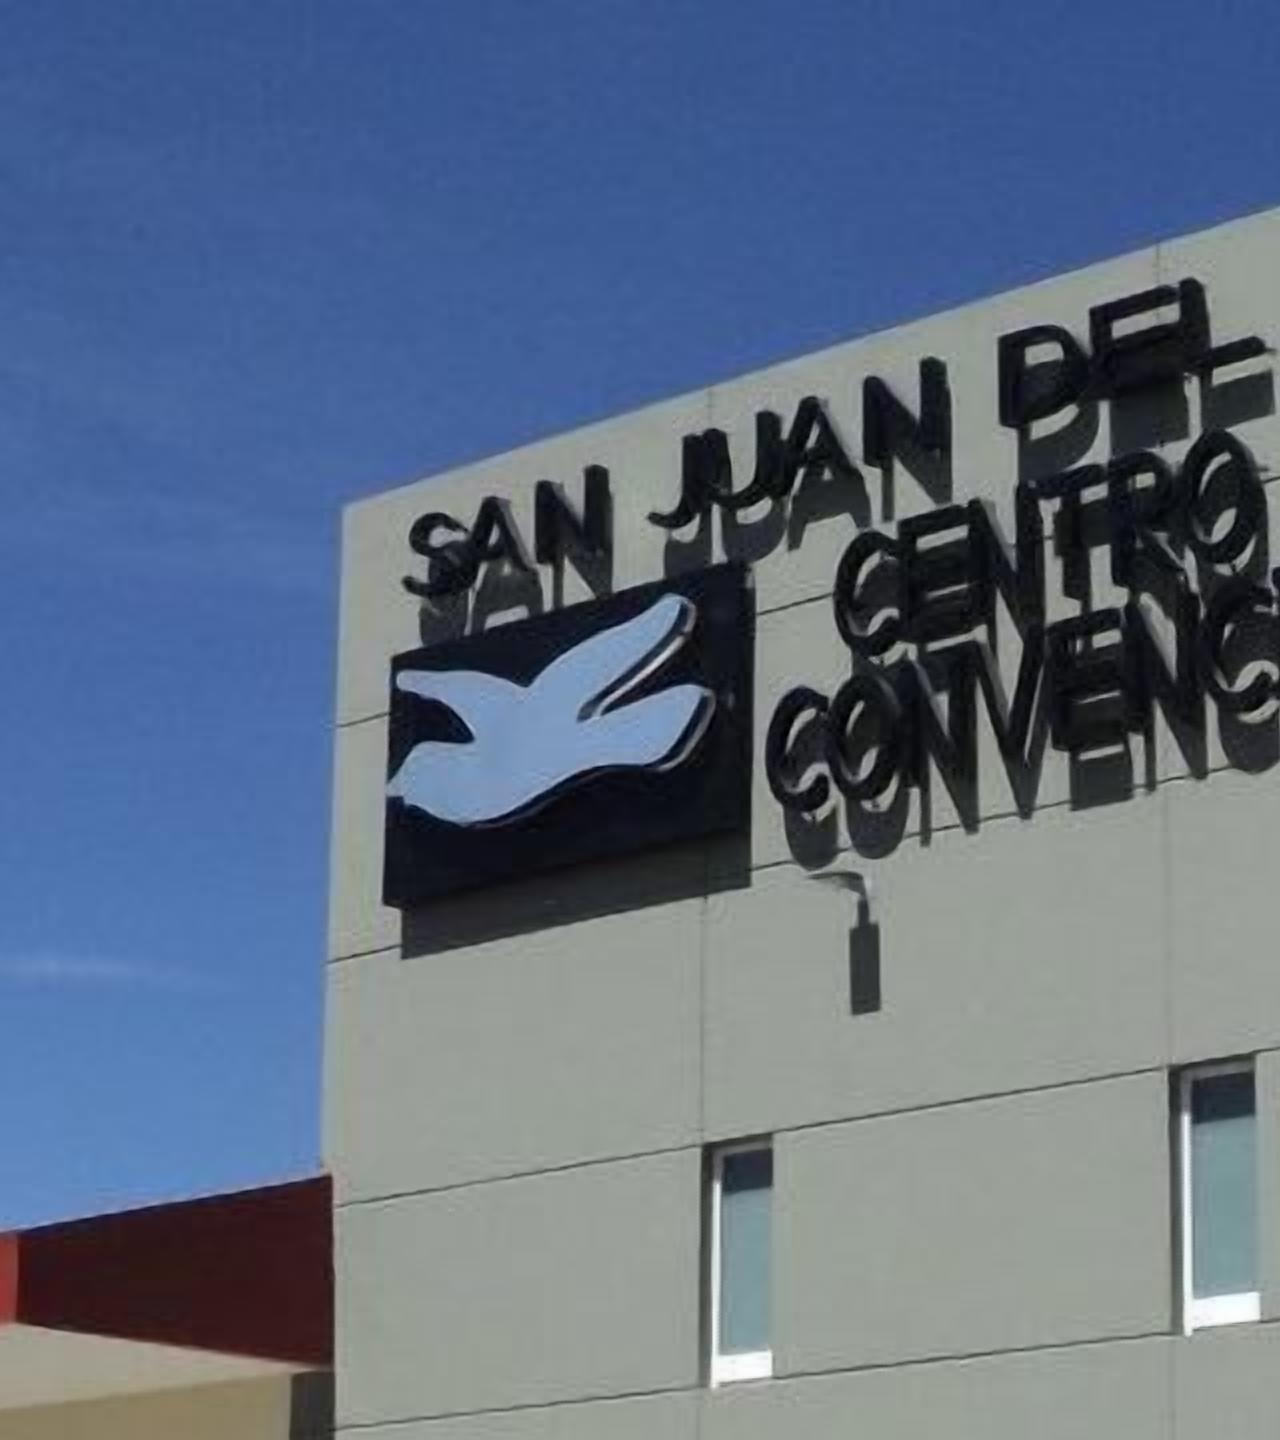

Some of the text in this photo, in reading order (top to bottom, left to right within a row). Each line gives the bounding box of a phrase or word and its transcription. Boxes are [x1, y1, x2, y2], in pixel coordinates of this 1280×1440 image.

[402, 464, 612, 598] SAN
[646, 356, 950, 530] JUAN
[998, 276, 1272, 428] DEL
[833, 427, 1262, 656] CENTRO
